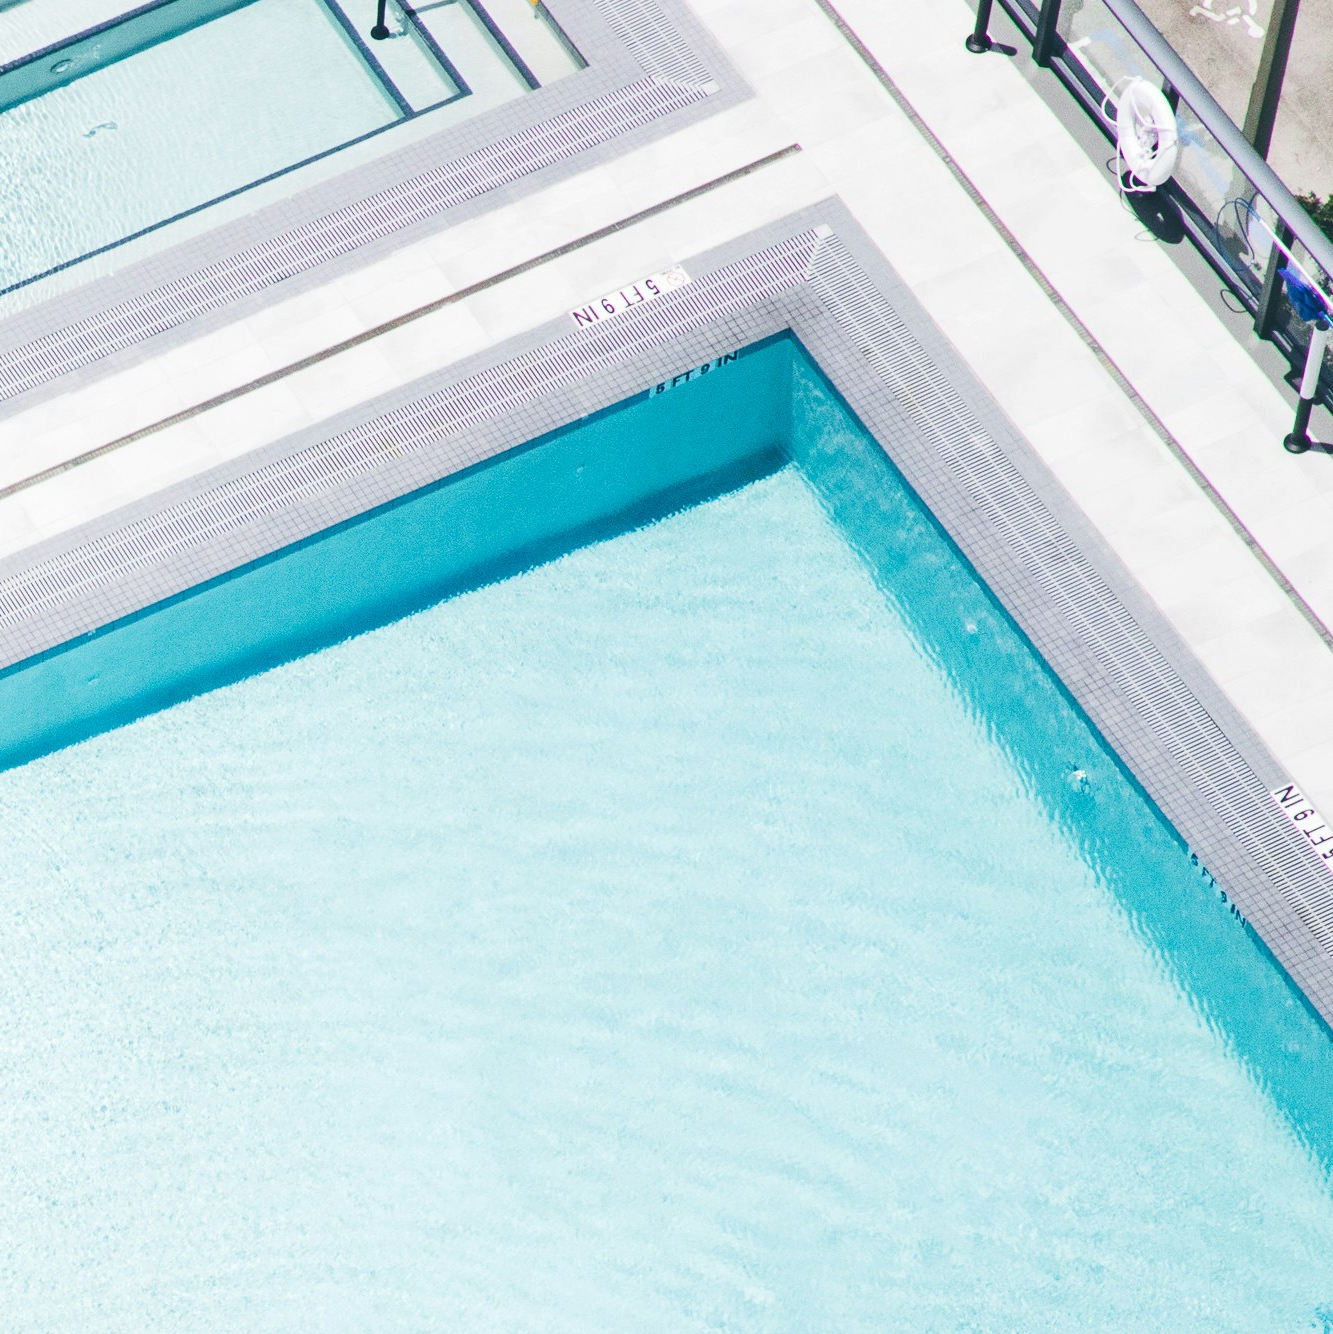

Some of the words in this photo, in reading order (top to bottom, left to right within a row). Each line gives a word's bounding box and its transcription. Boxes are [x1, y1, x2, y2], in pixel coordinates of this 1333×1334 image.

[619, 285, 645, 308] FT
[645, 279, 661, 295] 5
[572, 304, 599, 327] IN
[600, 298, 615, 314] 9
[655, 382, 666, 395] 5
[672, 369, 694, 388] FT
[700, 363, 711, 375] 9
[717, 350, 738, 368] IN
[1274, 785, 1305, 809] IN
[1293, 809, 1315, 821] 9
[1302, 824, 1333, 847] FT
[1201, 866, 1218, 889] FT
[1230, 903, 1247, 929] IN
